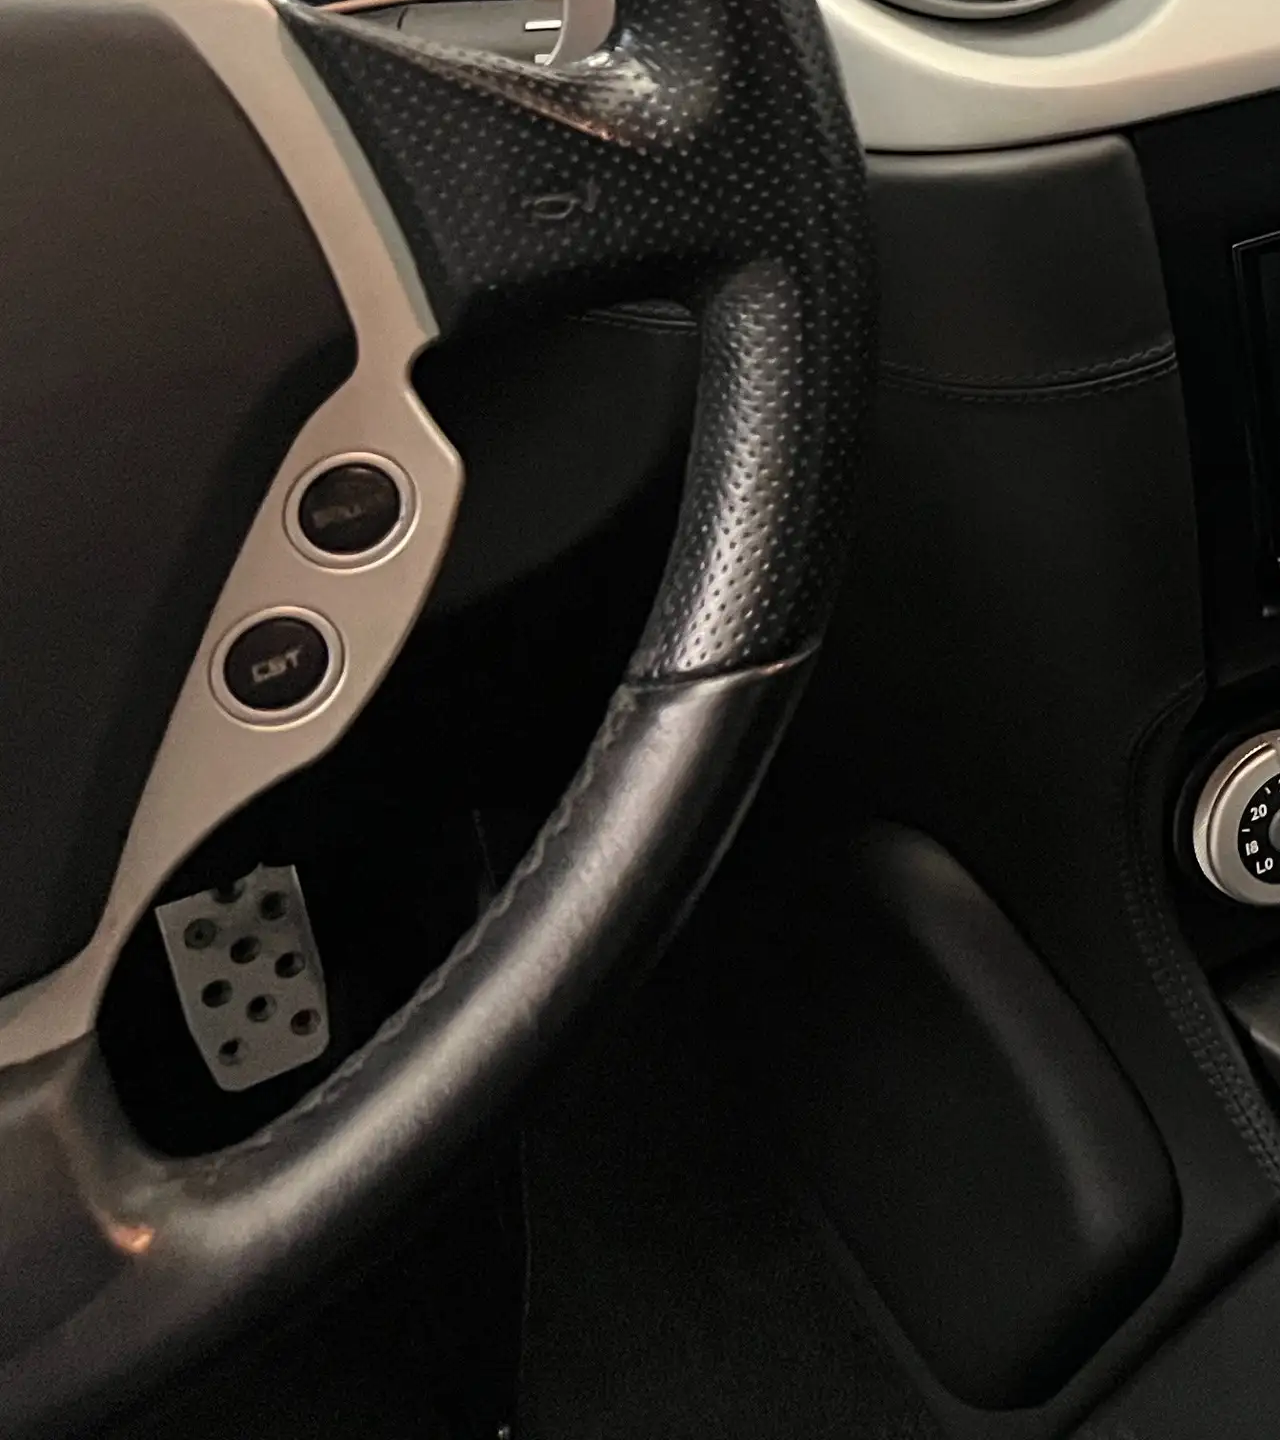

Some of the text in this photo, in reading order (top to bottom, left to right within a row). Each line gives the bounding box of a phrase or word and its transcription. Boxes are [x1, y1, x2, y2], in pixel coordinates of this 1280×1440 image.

[1250, 803, 1268, 821] 20
[1245, 840, 1259, 856] 18
[1255, 857, 1274, 875] LO
